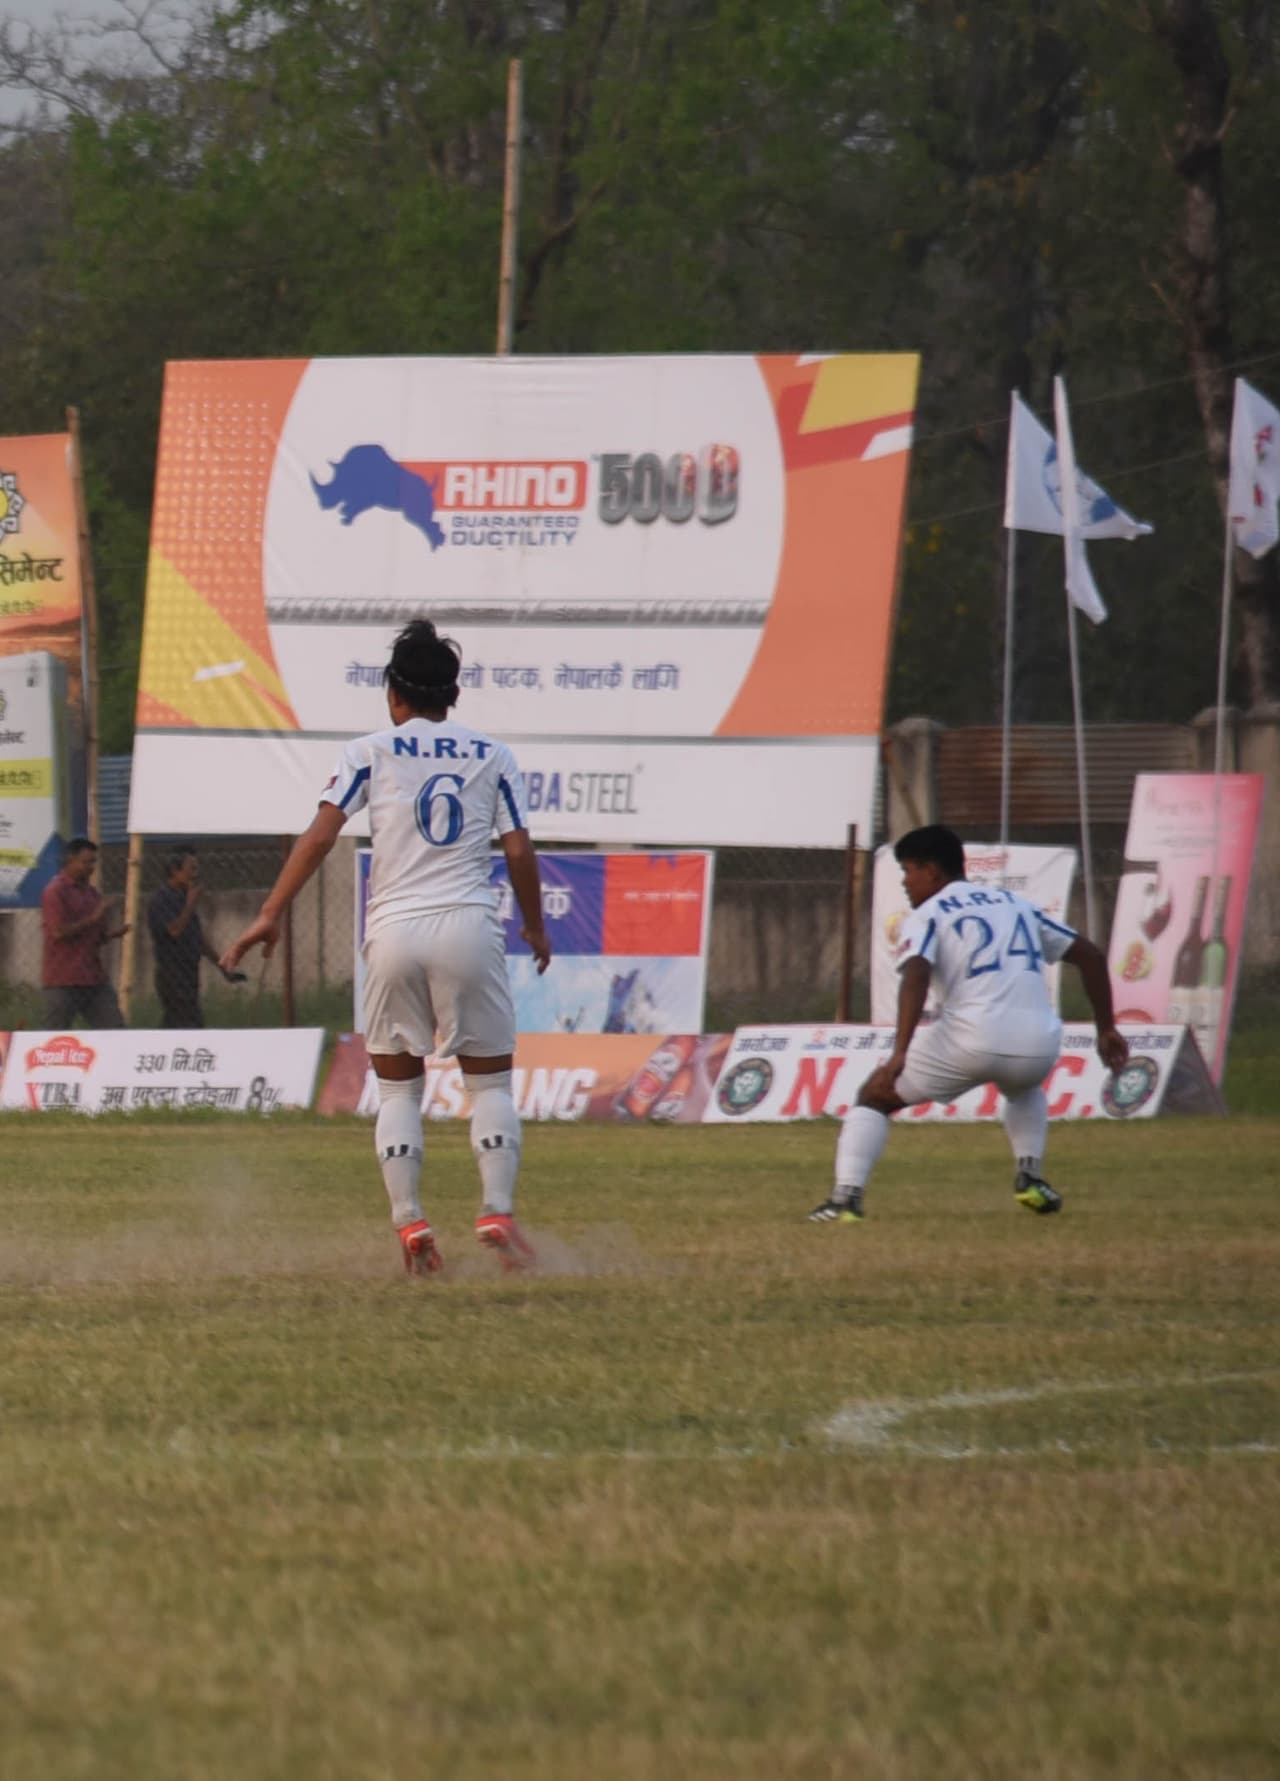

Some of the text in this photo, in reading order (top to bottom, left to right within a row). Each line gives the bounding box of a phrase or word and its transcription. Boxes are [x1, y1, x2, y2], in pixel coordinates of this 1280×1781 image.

[444, 466, 577, 507] RHINO
[451, 515, 580, 529] GUARANTEED
[451, 530, 577, 548] DUCTILITY
[414, 773, 465, 847] 6
[566, 773, 639, 814] STEEL
[953, 912, 1042, 980] 24
